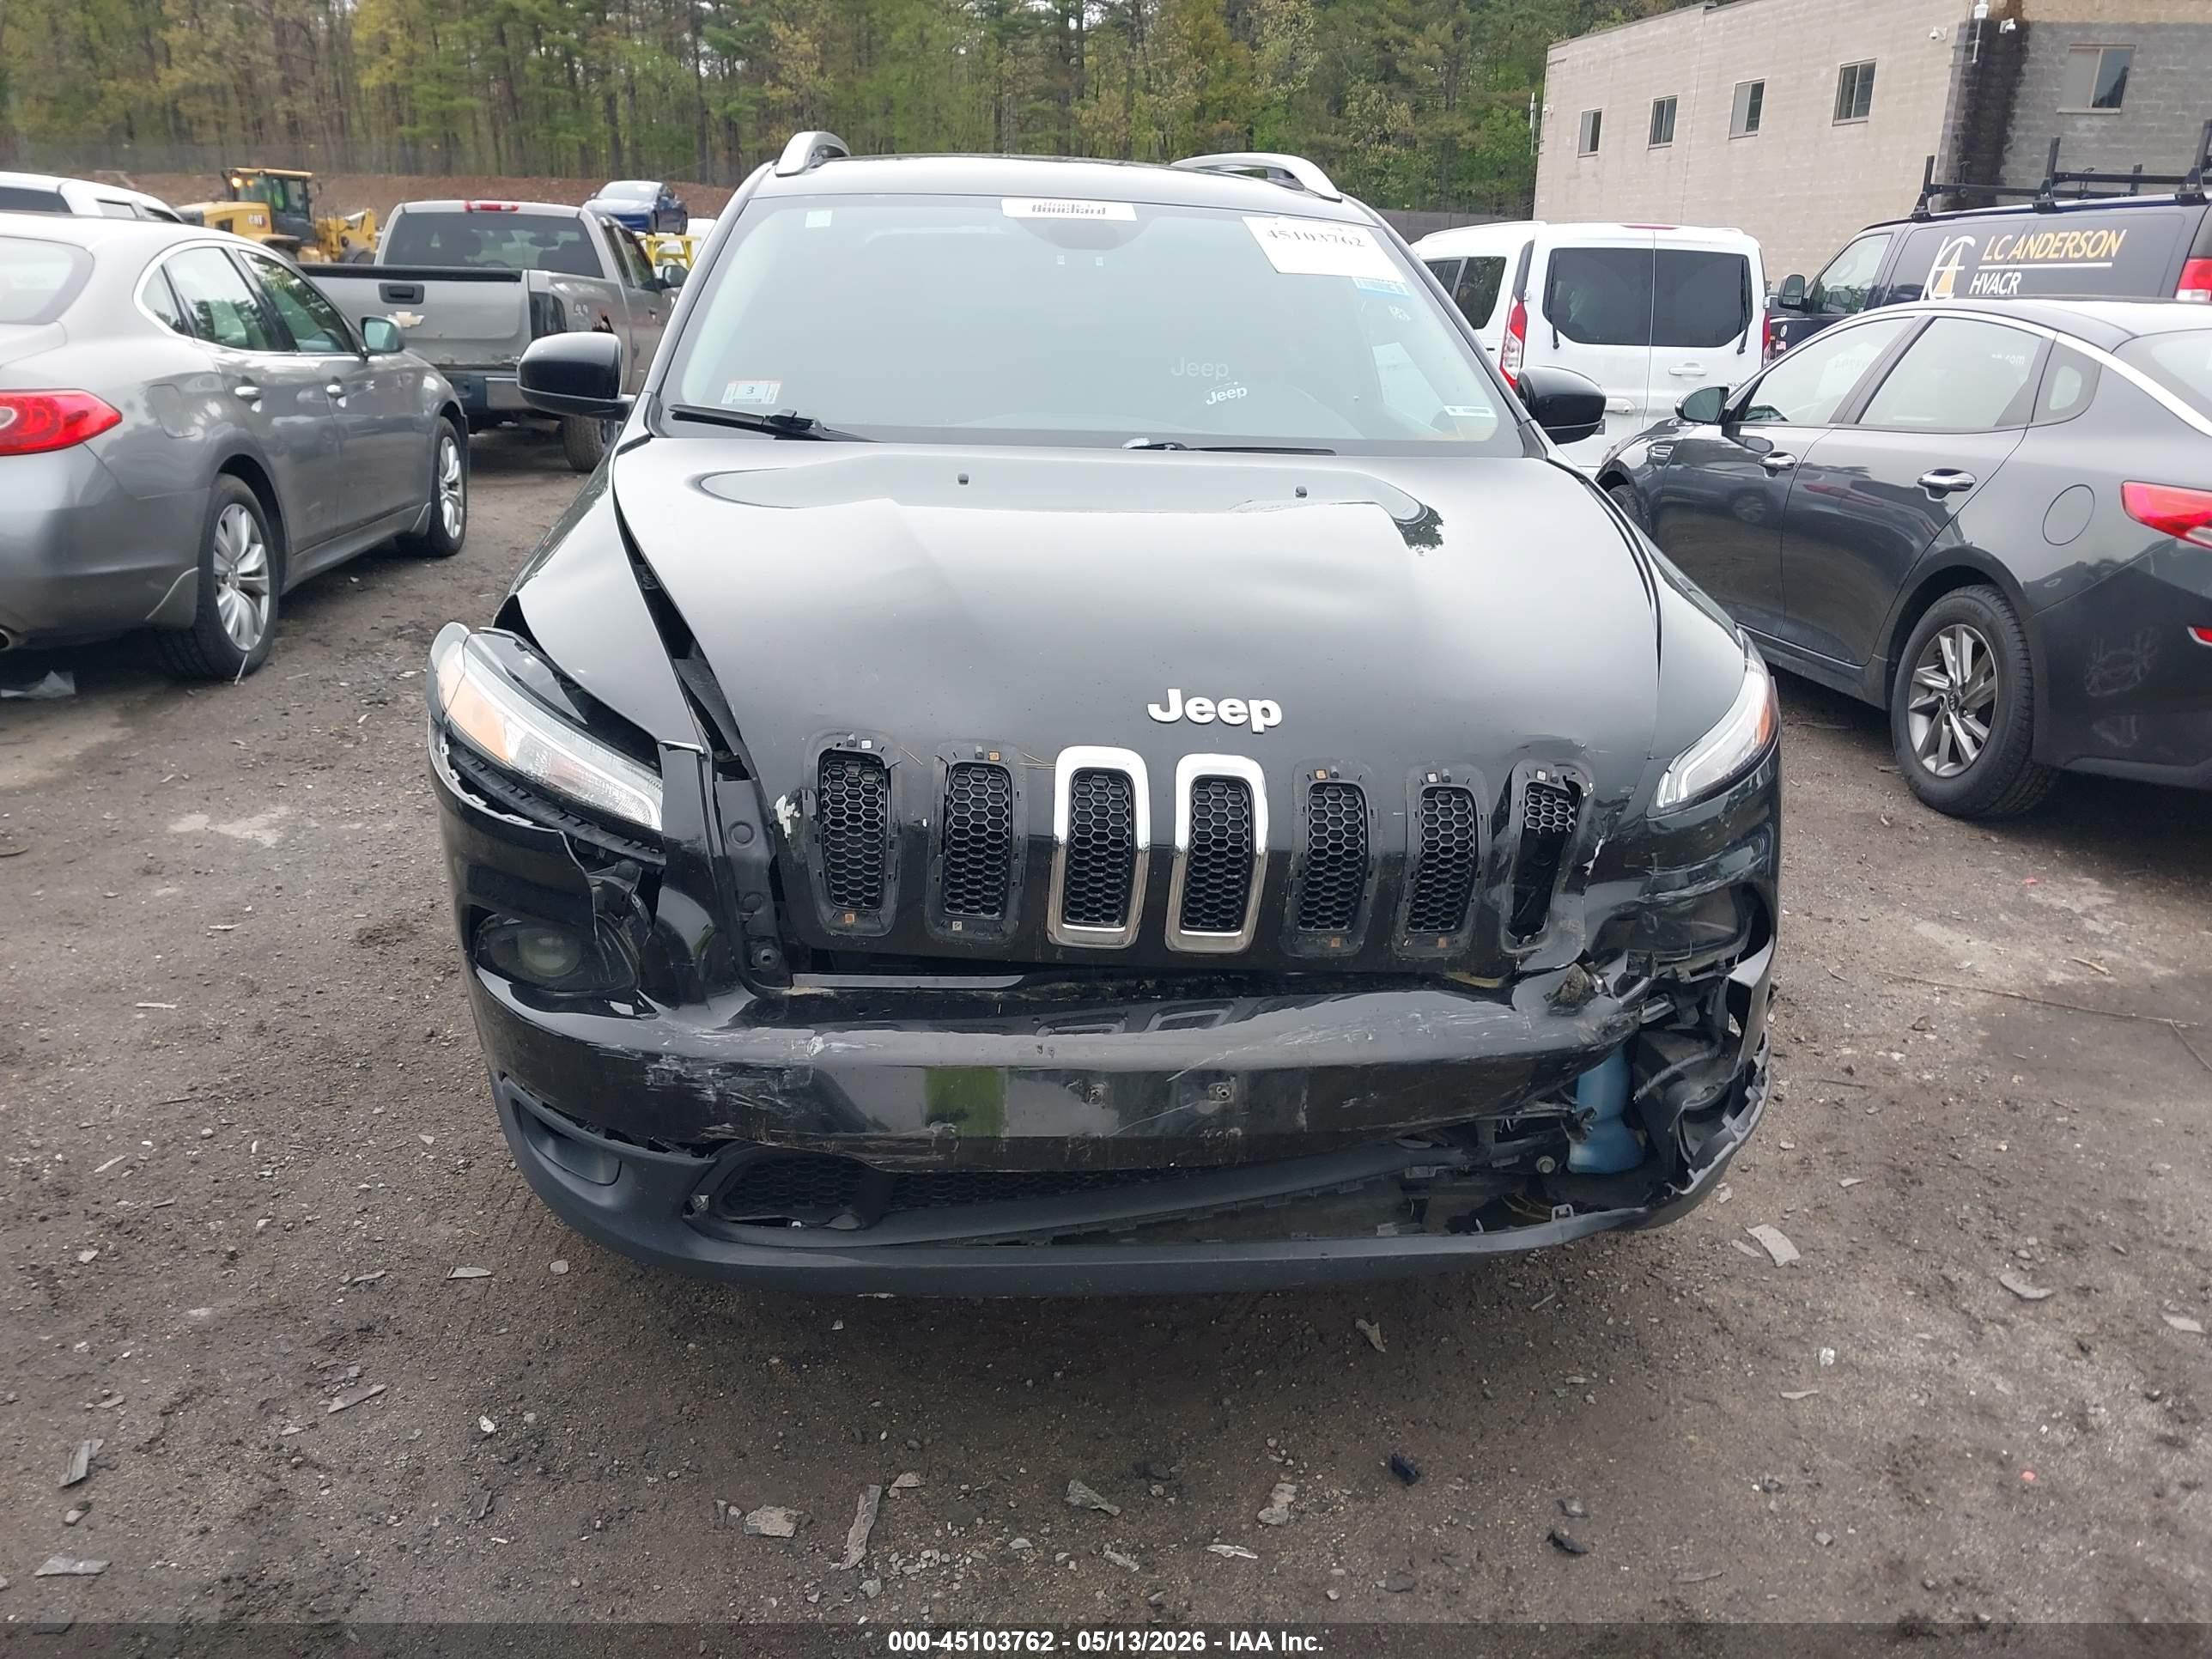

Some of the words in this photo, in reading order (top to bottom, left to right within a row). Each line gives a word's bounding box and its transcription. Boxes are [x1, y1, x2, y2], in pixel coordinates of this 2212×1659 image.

[1981, 234, 2014, 261] LC
[2007, 228, 2127, 260] ANDERSON
[1968, 271, 2022, 295] HVACR
[1170, 356, 1230, 380] Jeep
[745, 386, 755, 395] 3
[1206, 387, 1248, 405] Jeep
[1146, 688, 1283, 734] Jeep
